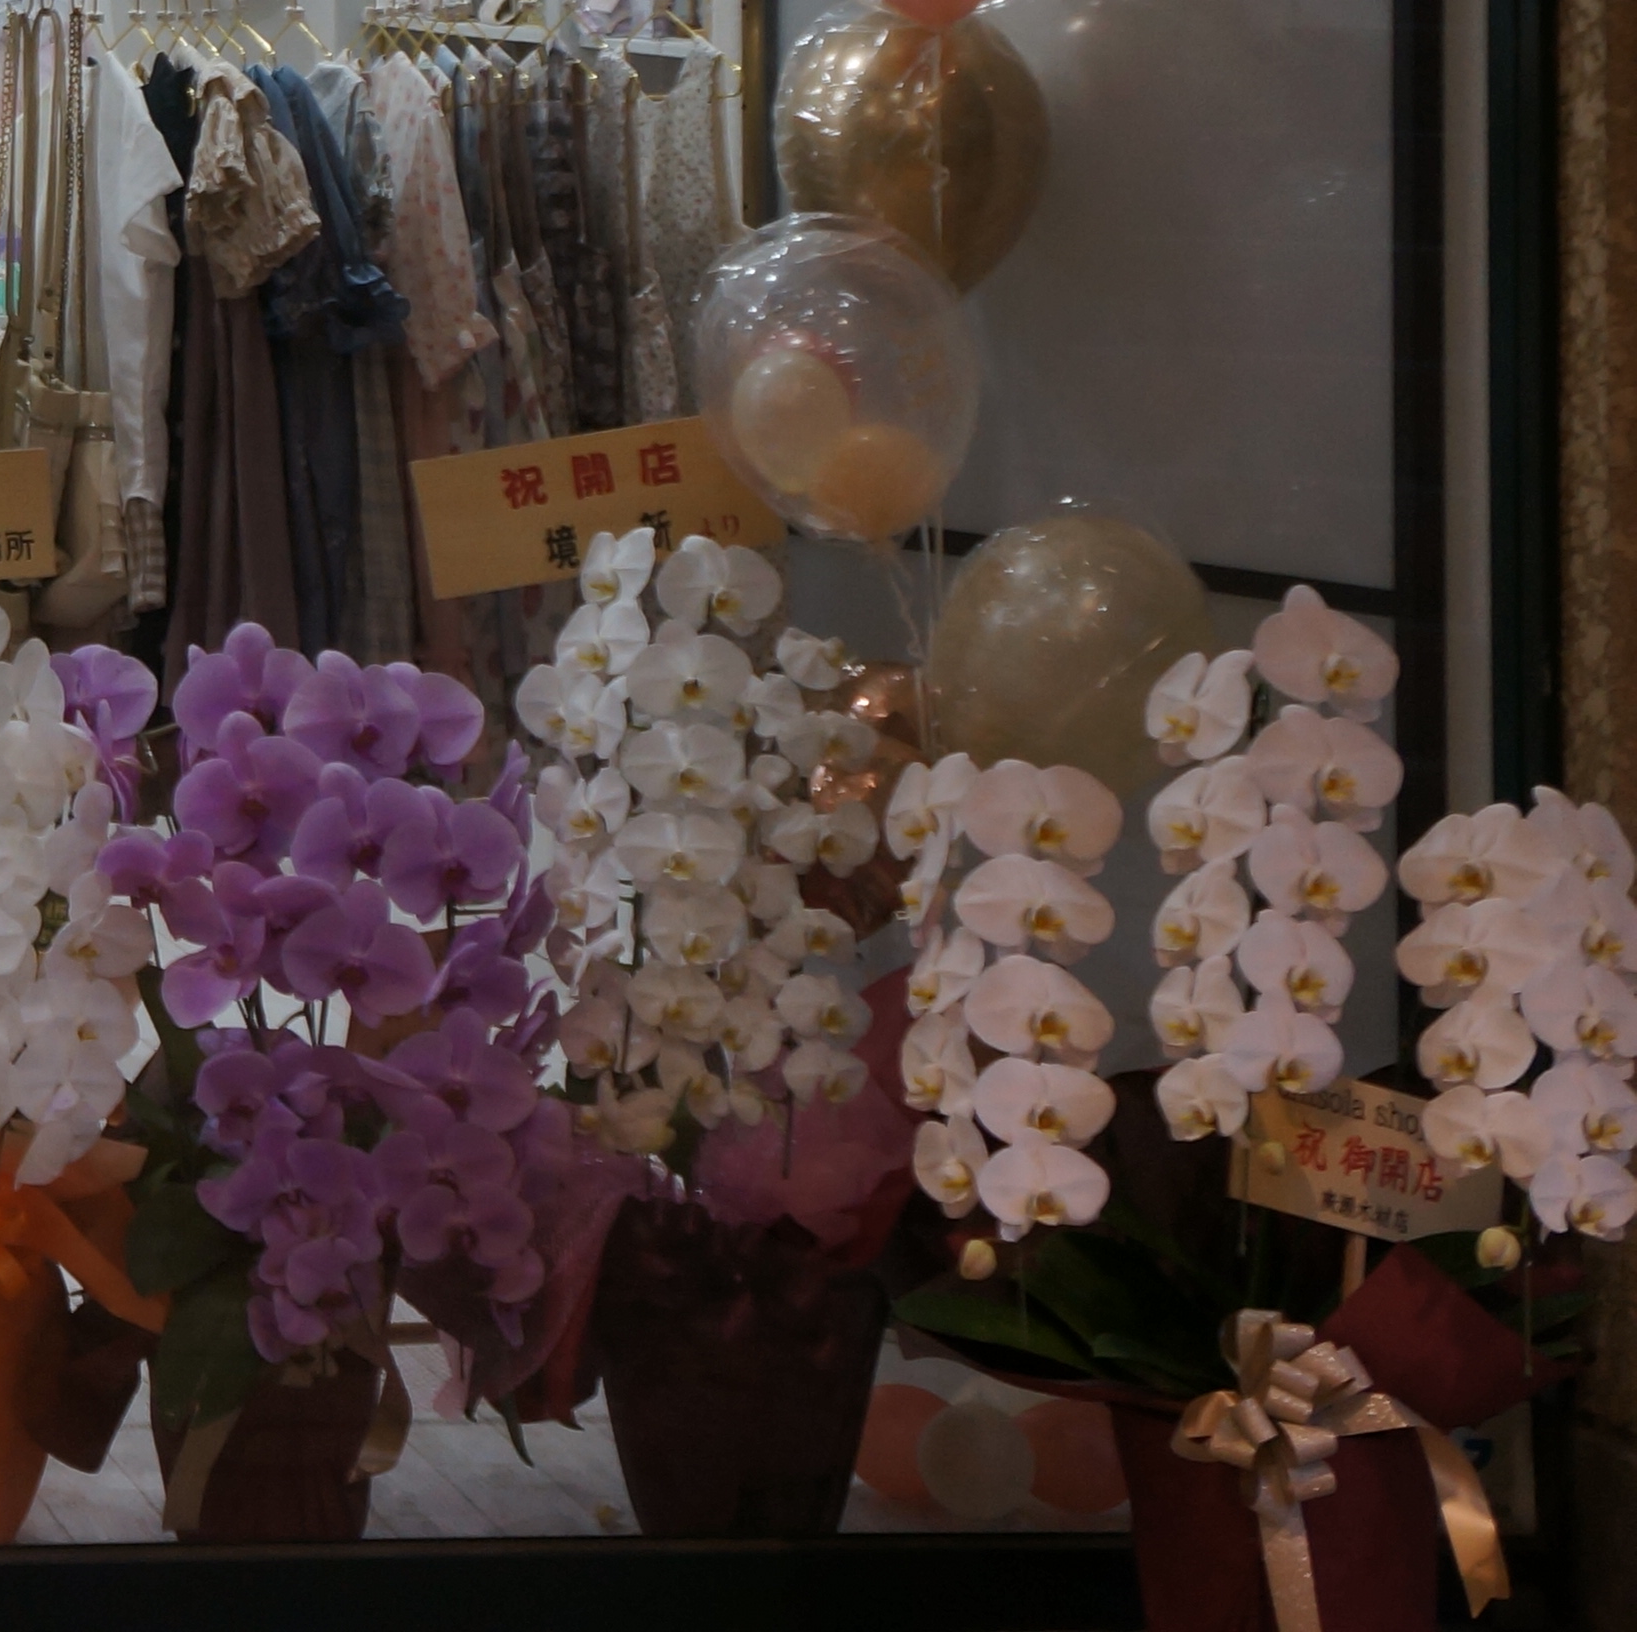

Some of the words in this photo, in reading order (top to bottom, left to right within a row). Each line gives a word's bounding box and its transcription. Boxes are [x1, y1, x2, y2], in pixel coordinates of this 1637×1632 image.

[500, 443, 682, 510] 祝開店
[1374, 1101, 1424, 1142] sho
